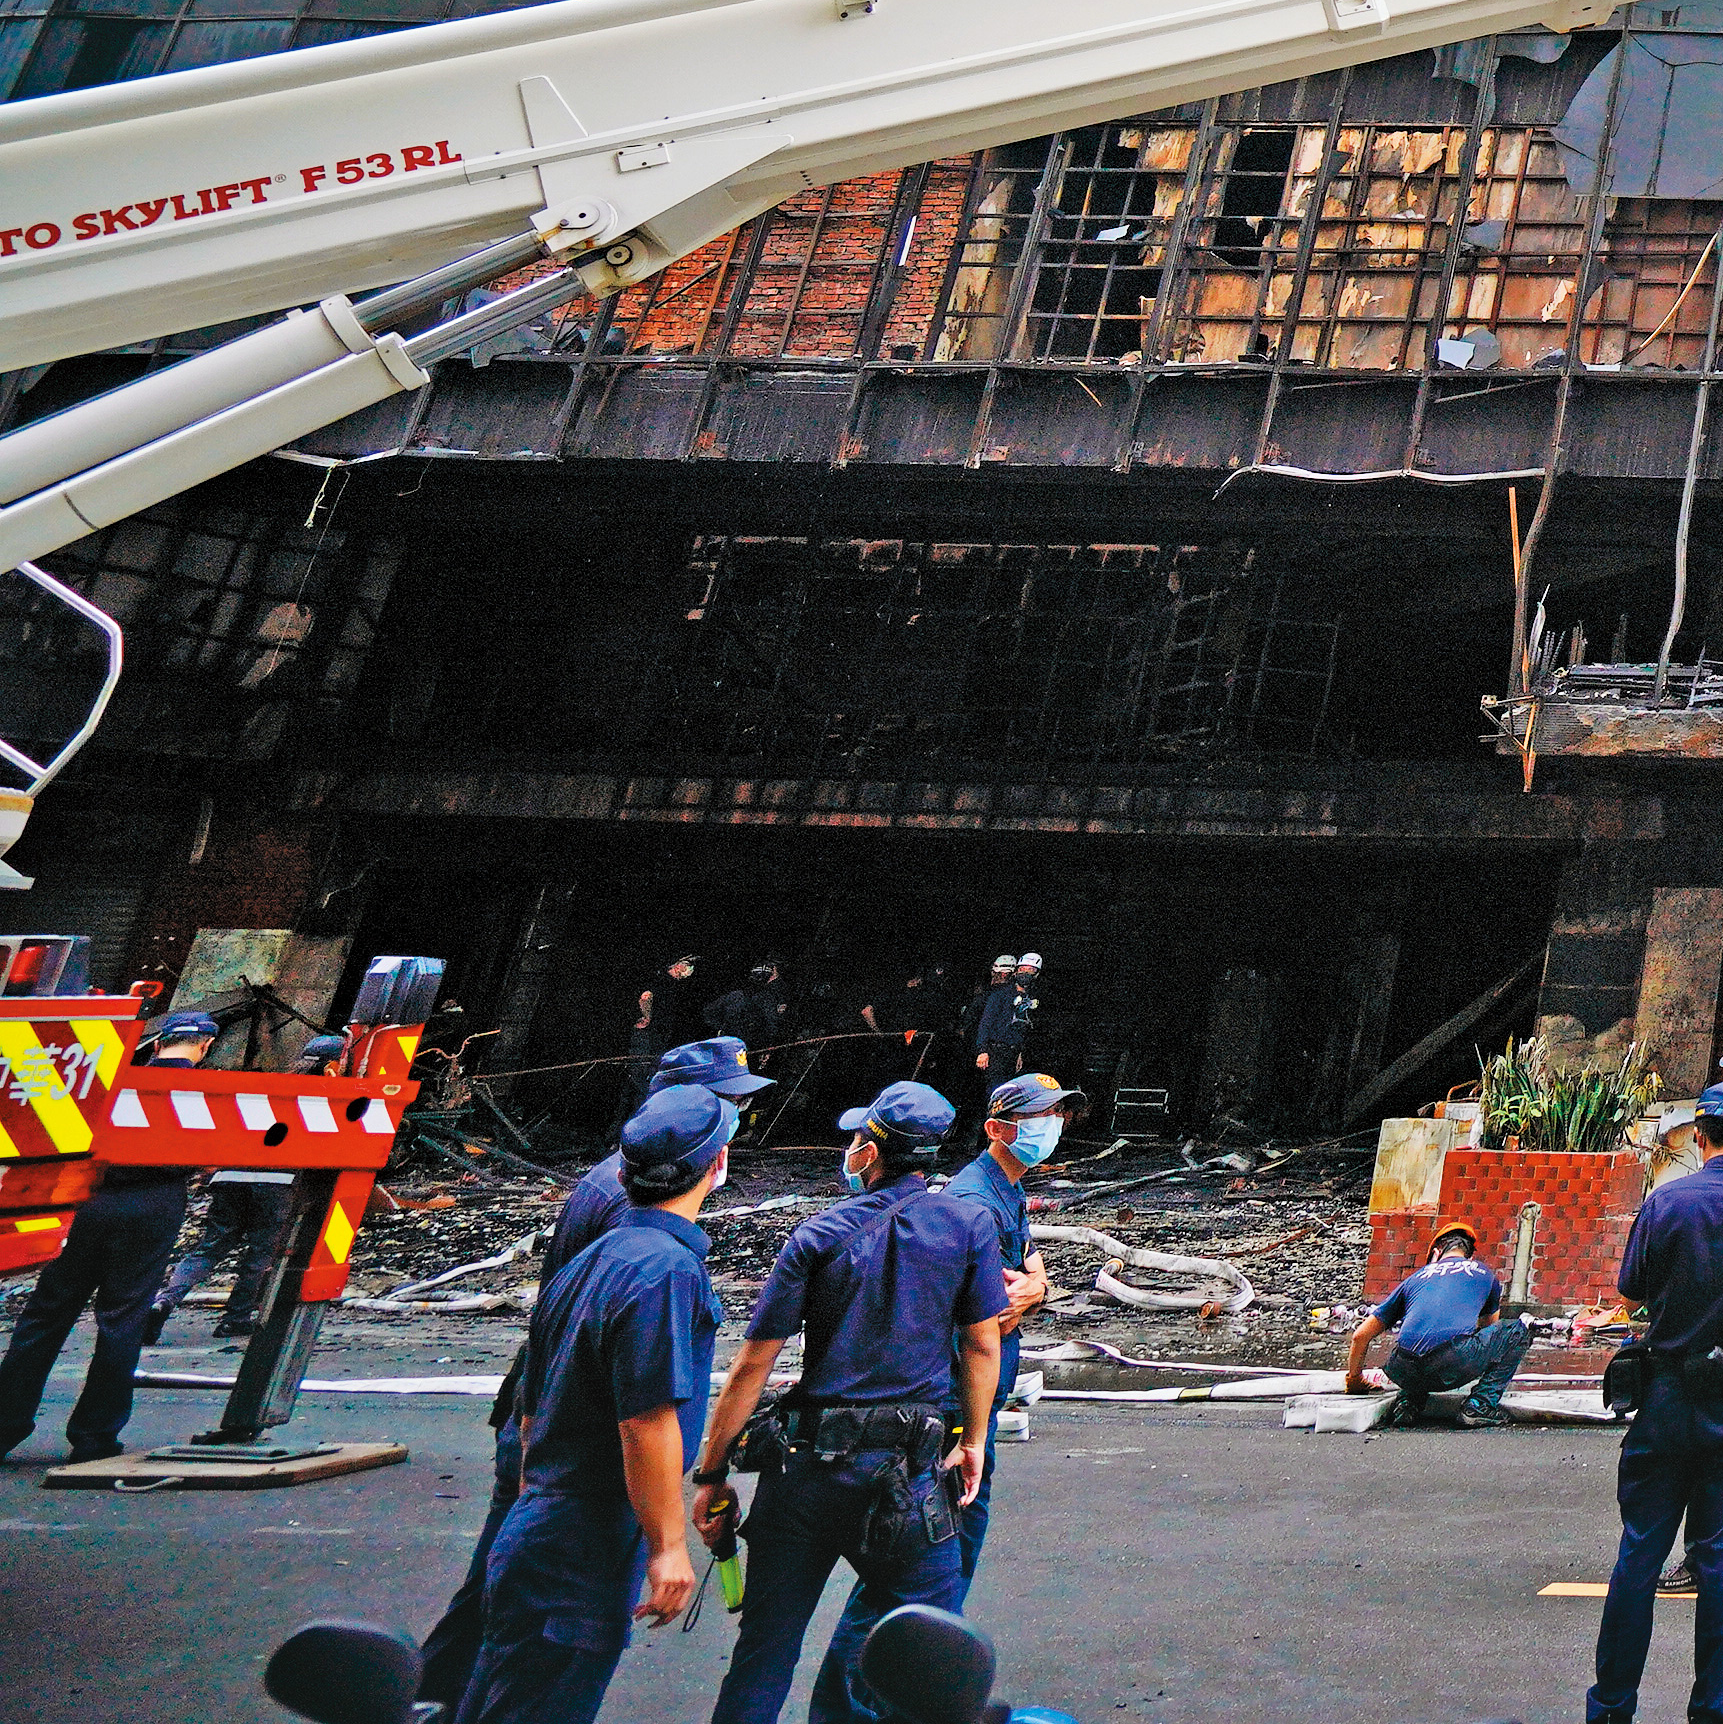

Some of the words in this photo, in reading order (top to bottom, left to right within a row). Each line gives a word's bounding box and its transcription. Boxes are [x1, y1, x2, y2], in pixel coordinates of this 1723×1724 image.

[72, 176, 272, 241] SKYLIFT
[300, 165, 326, 193] F
[336, 152, 395, 185] 53
[401, 140, 462, 172] RL
